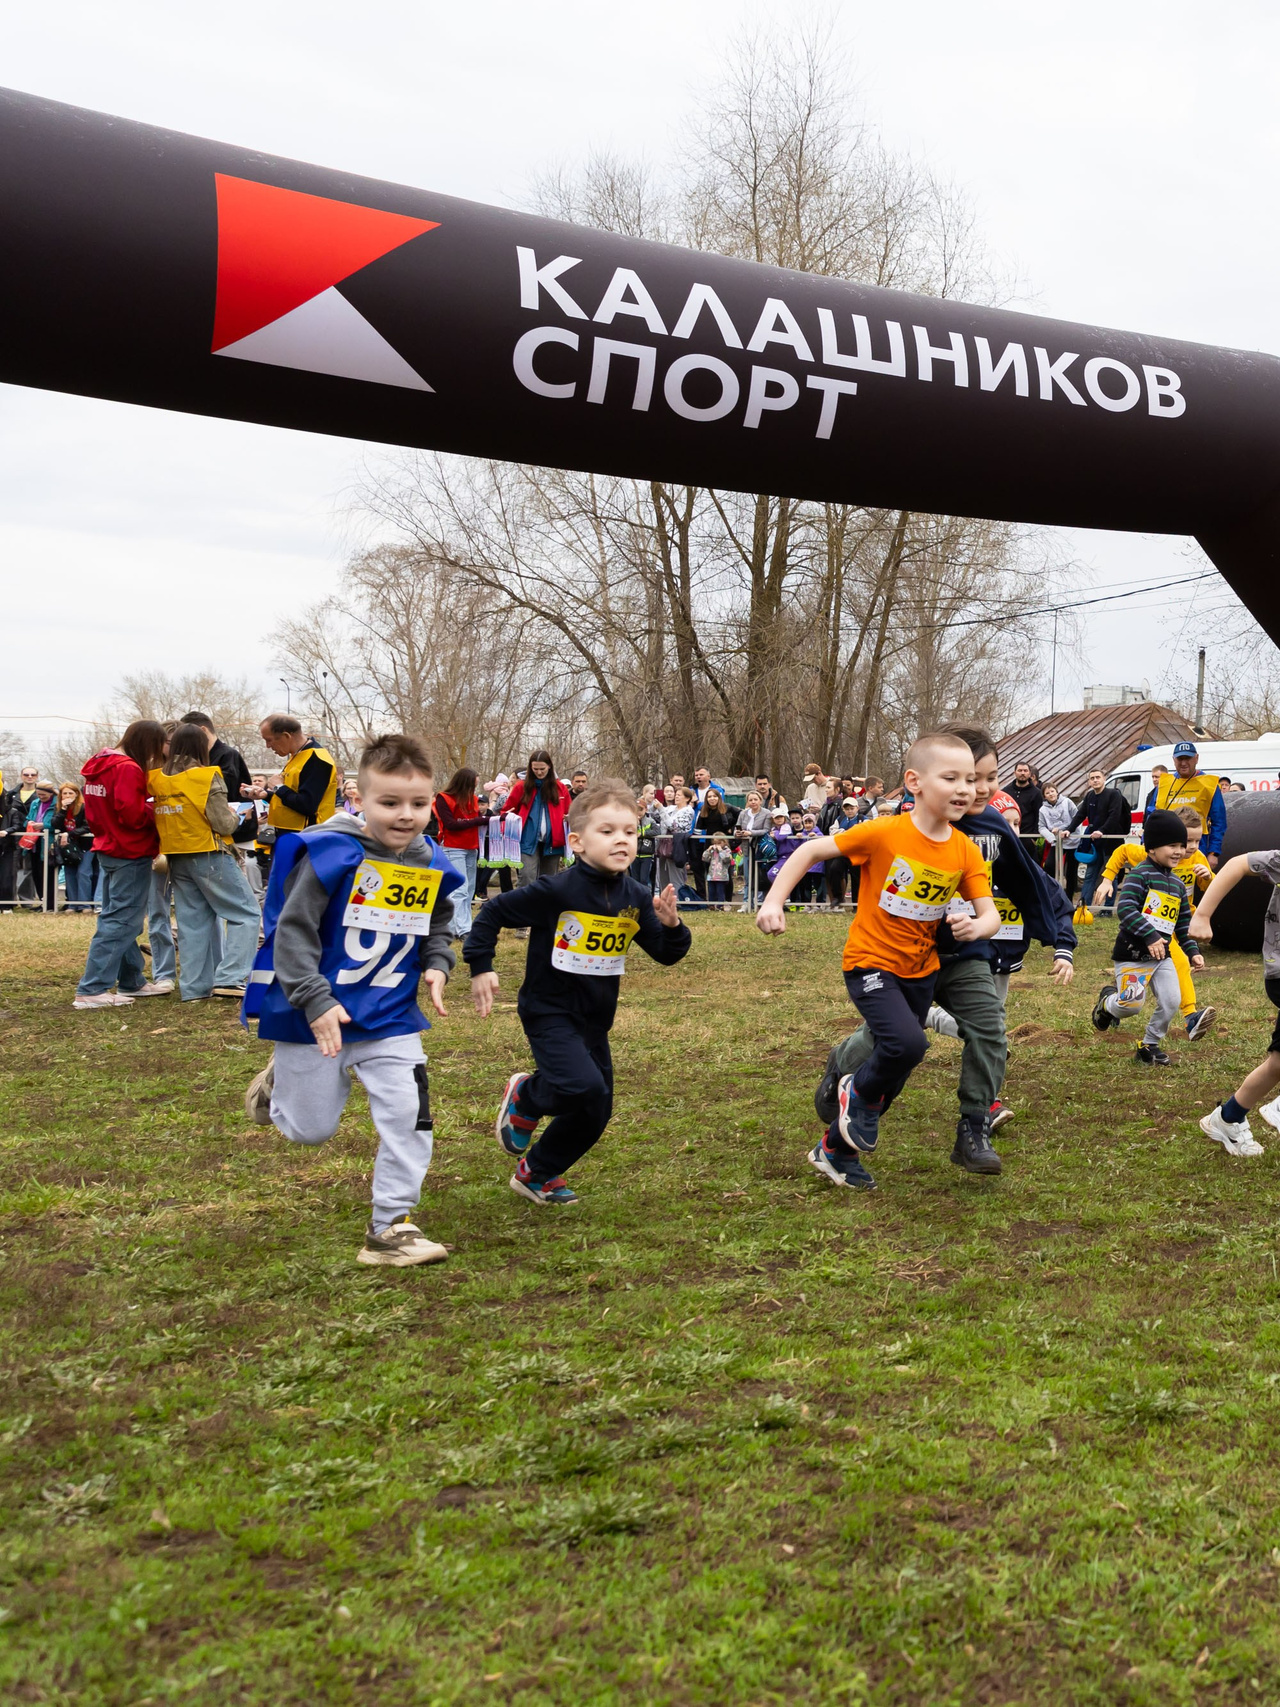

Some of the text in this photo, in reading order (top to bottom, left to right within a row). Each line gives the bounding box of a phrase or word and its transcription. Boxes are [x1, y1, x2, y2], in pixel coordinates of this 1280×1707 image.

[514, 245, 1187, 420] КАЛАШНИКОВ
[512, 326, 859, 440] СПОРТ
[384, 883, 430, 908] 364
[914, 880, 952, 902] 379
[335, 926, 415, 988] 92
[585, 931, 627, 953] 503
